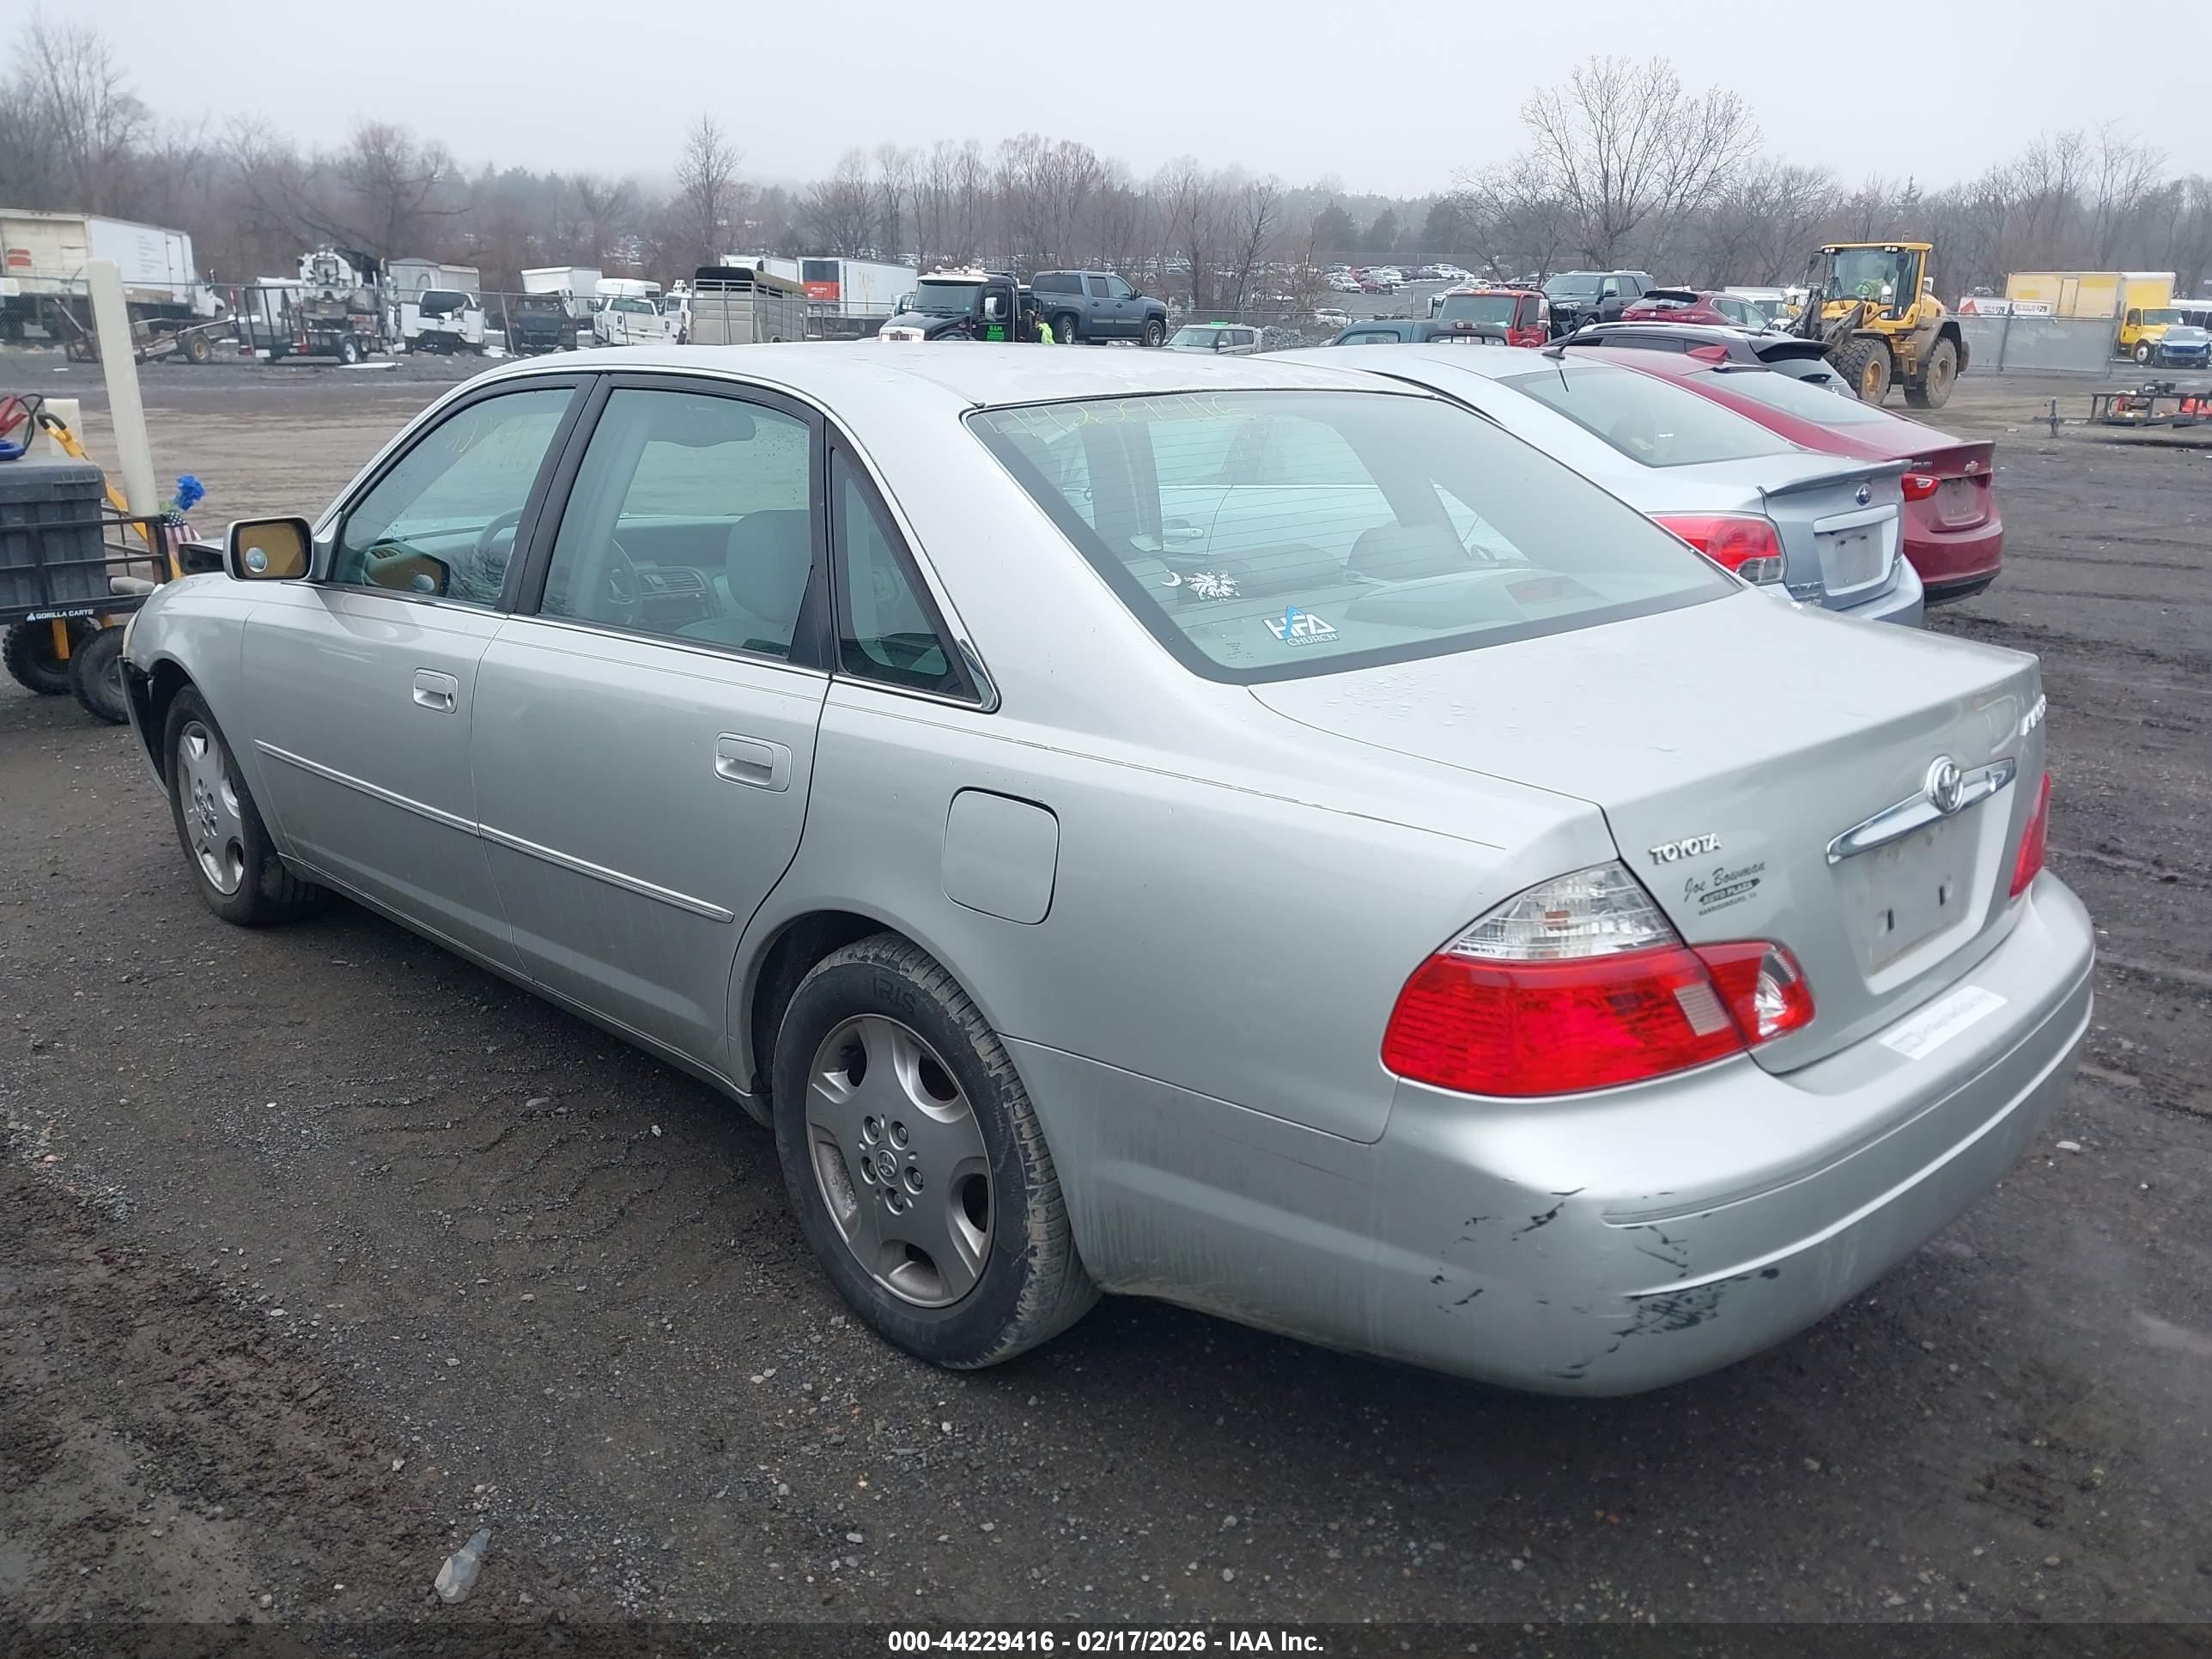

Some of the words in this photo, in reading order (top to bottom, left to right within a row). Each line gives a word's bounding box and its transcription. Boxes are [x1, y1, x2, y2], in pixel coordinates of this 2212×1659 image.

[35, 611, 67, 620] GORILLA
[68, 608, 94, 617] CARTS
[1263, 605, 1339, 640] HFA
[1286, 633, 1339, 647] CHURCH
[1650, 833, 1721, 865] TOYOTA
[1684, 877, 1706, 902] Joe
[1711, 861, 1765, 886] Bowman
[872, 977, 915, 1014] IRIS
